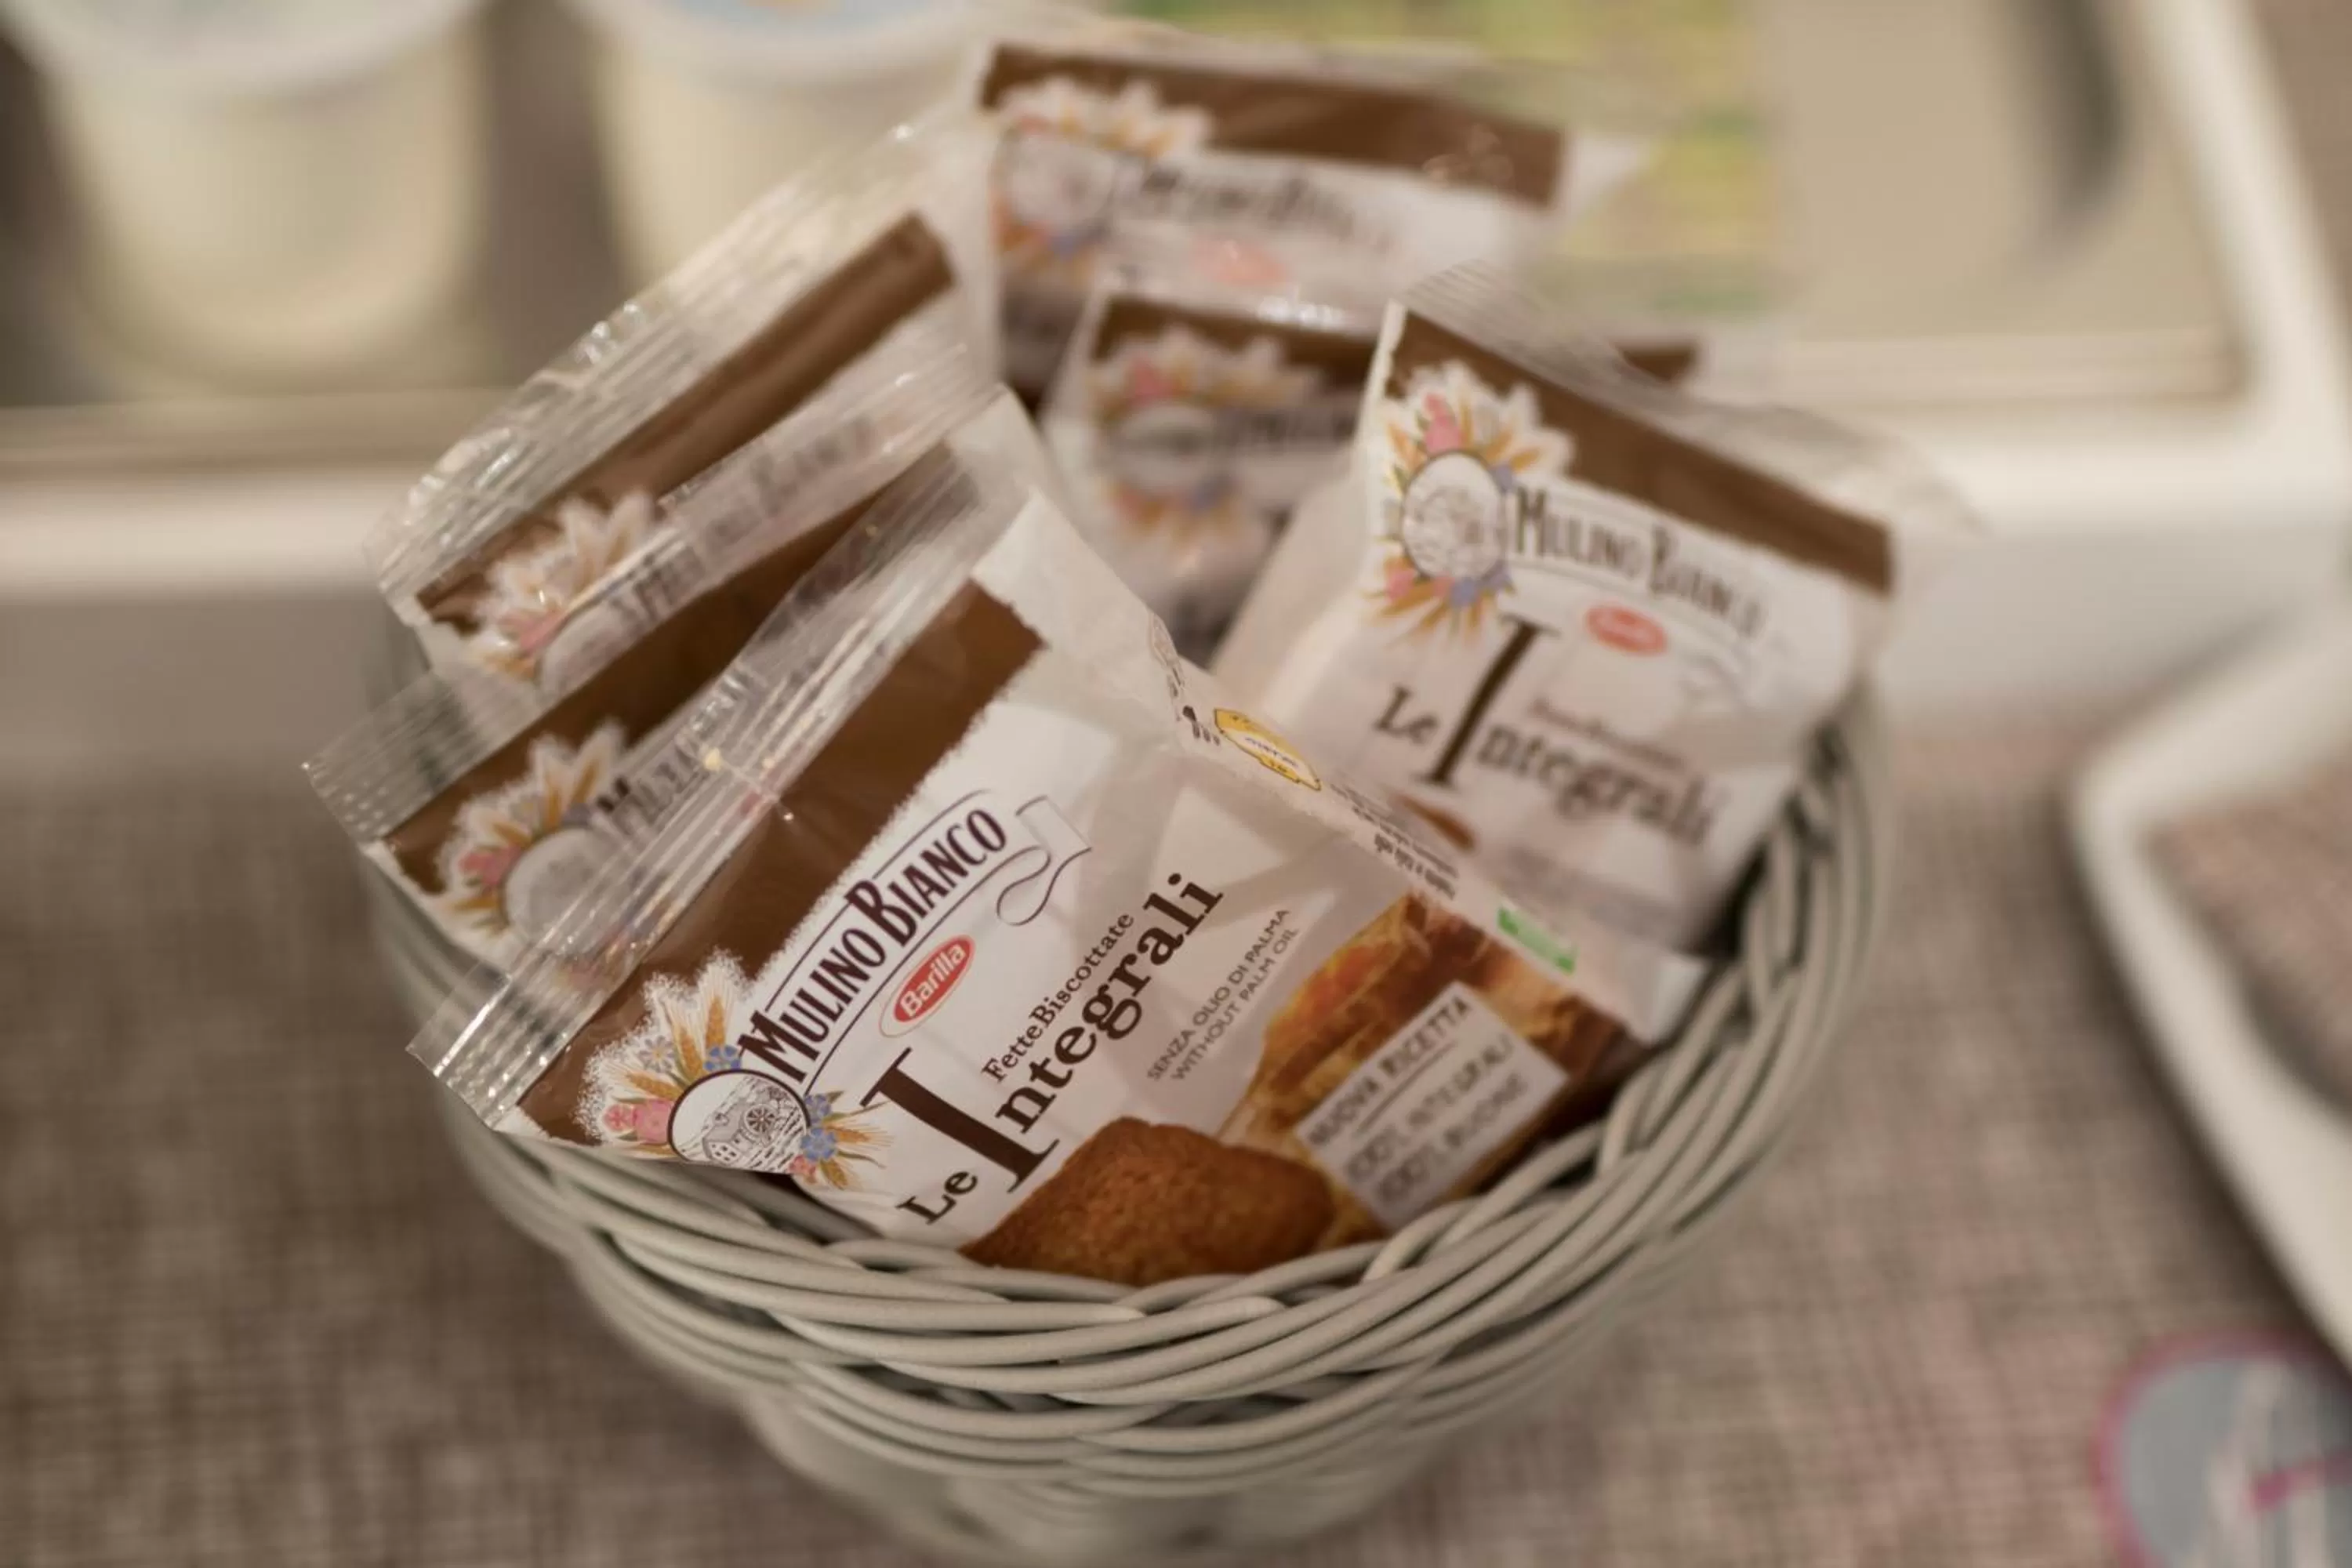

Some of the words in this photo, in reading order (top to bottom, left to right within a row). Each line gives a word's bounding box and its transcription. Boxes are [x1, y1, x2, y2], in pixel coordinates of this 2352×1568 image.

[1372, 686, 1439, 743] Le
[736, 927, 887, 1086] MULINO
[844, 808, 1008, 947] BIANCO
[897, 942, 967, 1019] Barilla
[1147, 1029, 1196, 1081] SENZA
[1192, 985, 1232, 1027] OLIO
[1226, 964, 1250, 985] DI
[1243, 909, 1291, 964] PALMA
[1170, 1001, 1241, 1080] WITHOUT
[1238, 956, 1277, 1002] PALM
[1272, 928, 1300, 955] OIL
[859, 872, 1225, 1193] Integrali
[1307, 1074, 1381, 1148] NUOVA
[1377, 995, 1474, 1080] RICETTA
[897, 1171, 978, 1225] Le
